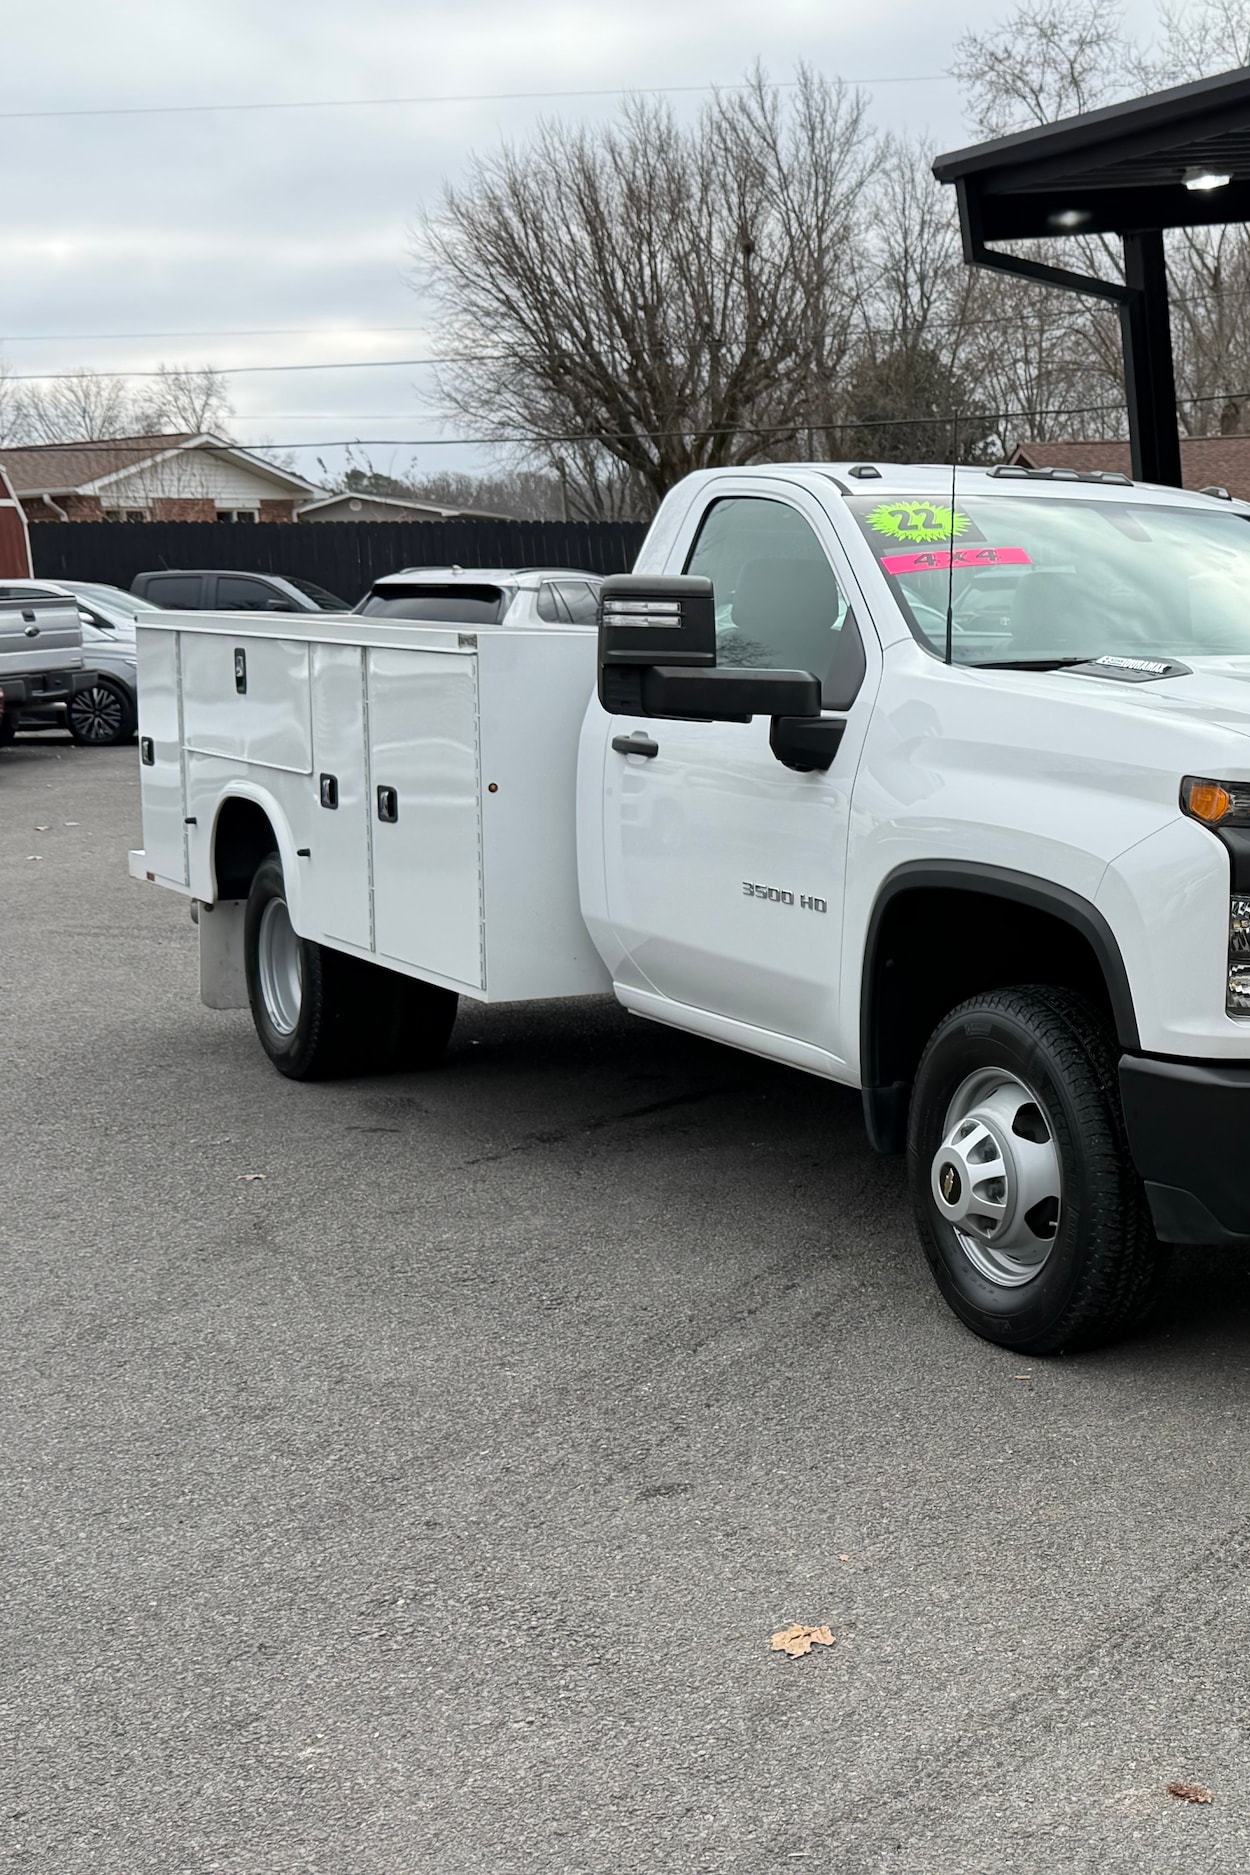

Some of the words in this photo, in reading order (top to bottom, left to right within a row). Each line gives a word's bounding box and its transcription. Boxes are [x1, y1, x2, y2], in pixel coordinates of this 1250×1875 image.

[888, 508, 942, 531] 22
[742, 881, 794, 905] 3500
[800, 893, 827, 913] HD
